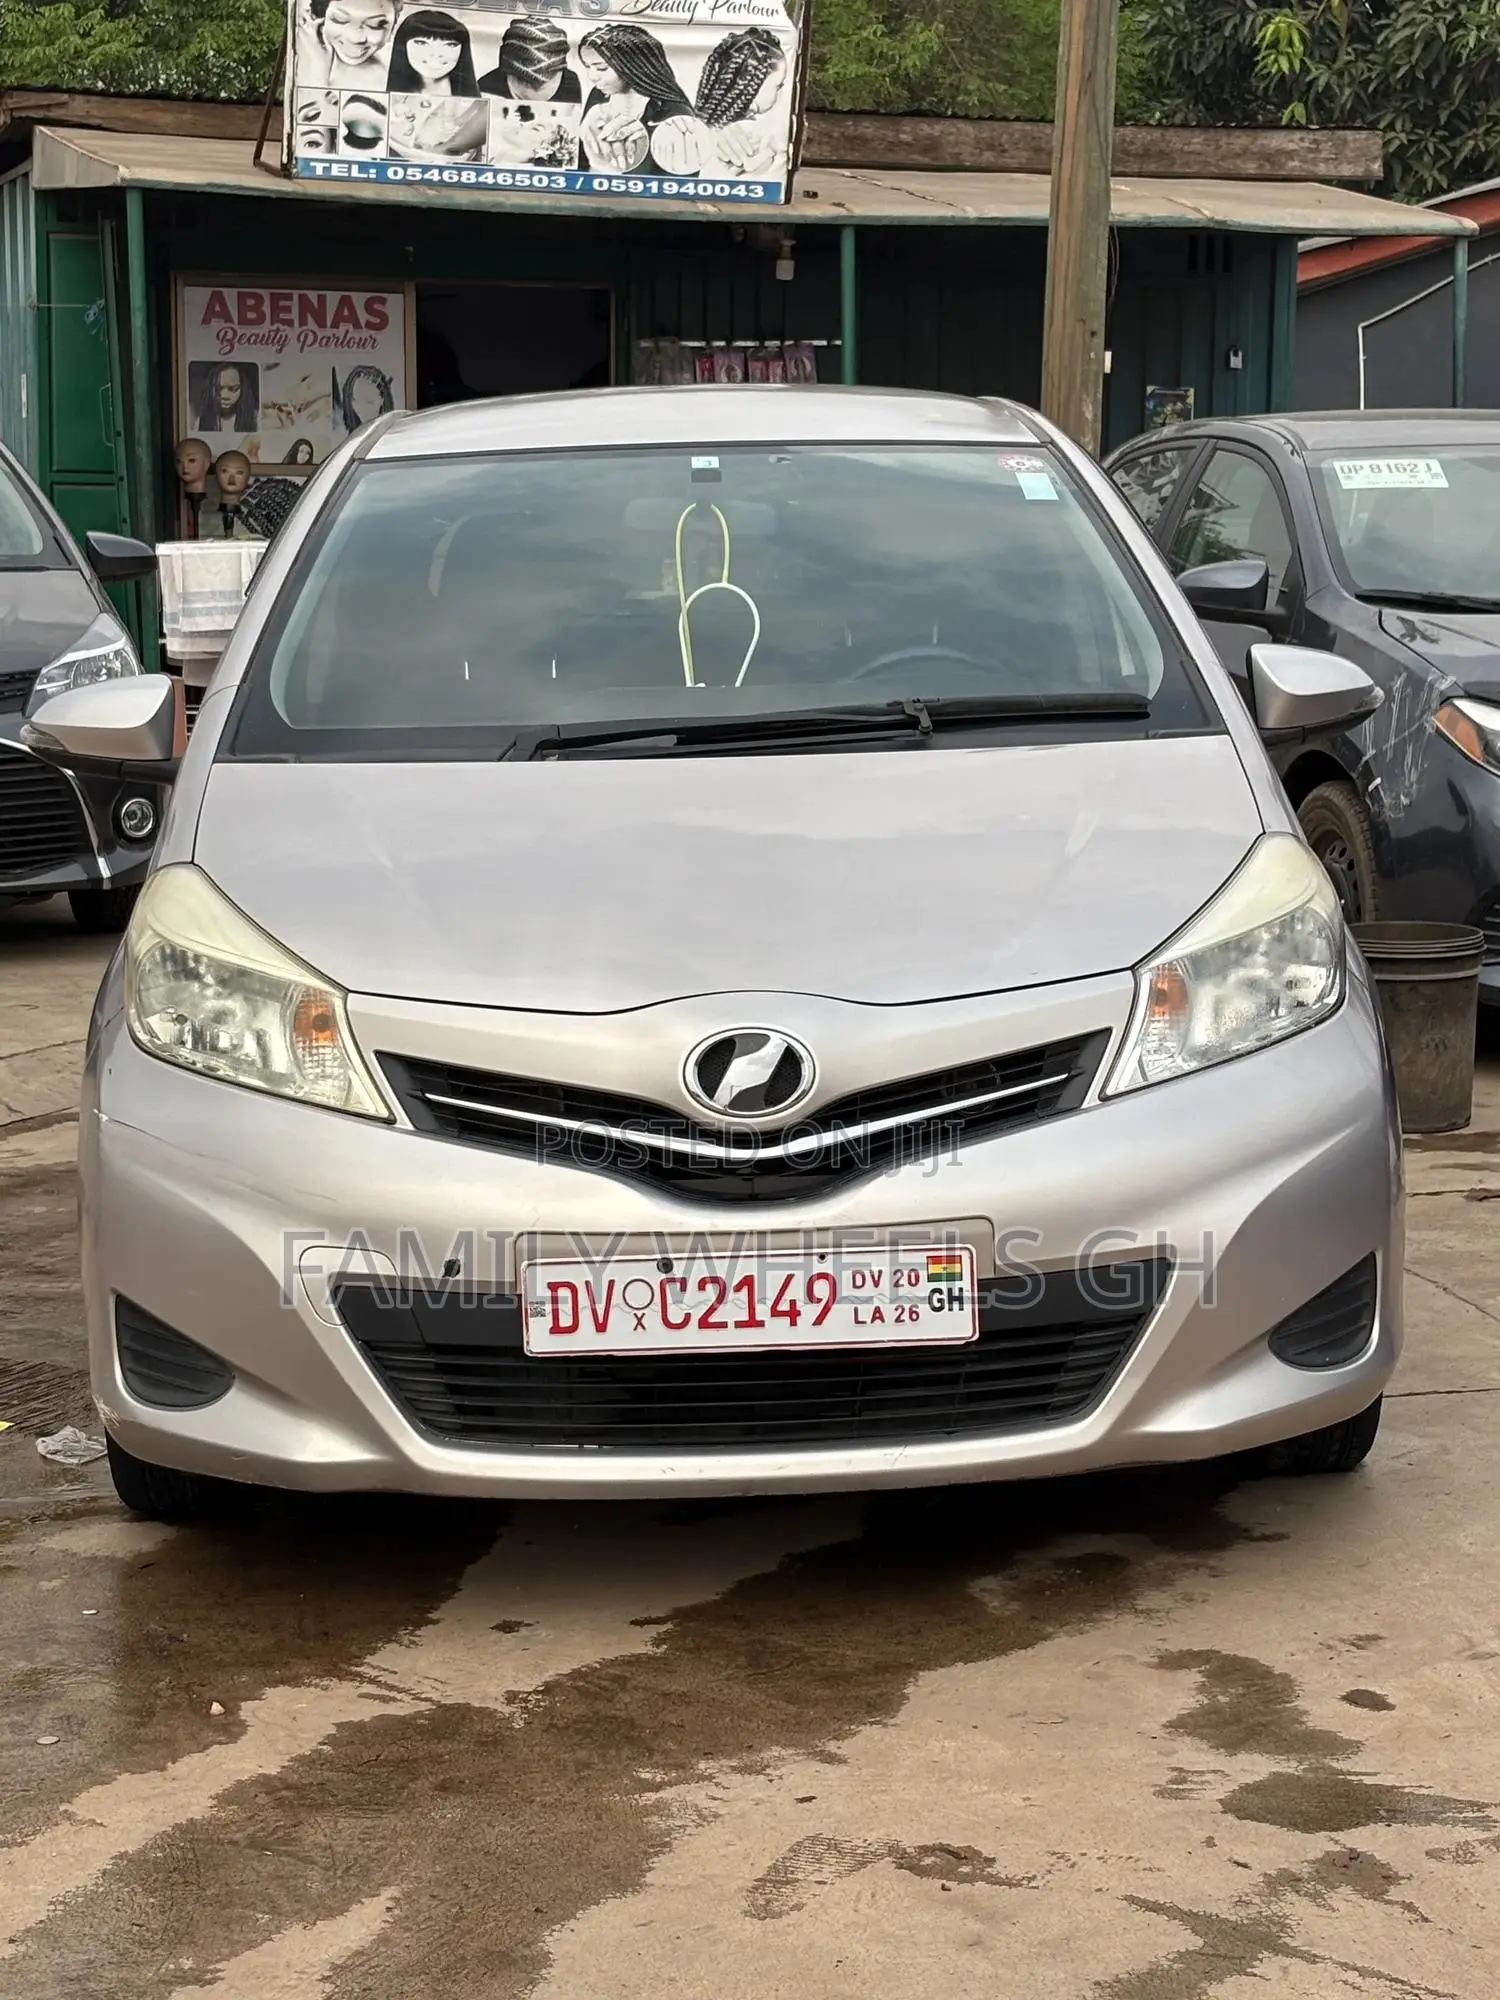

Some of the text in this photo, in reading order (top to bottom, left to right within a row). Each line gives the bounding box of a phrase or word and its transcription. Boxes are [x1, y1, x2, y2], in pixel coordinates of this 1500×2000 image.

[310, 162, 765, 198] TEL: 0546846503 / 0591940043
[200, 290, 390, 332] ABENAS
[216, 322, 380, 356] Beauty Parlour
[851, 1268, 921, 1290] DV 20
[547, 1279, 615, 1334] DV
[659, 1271, 838, 1330] C2149
[853, 1304, 920, 1325] LA 26
[928, 1287, 965, 1313] GH
